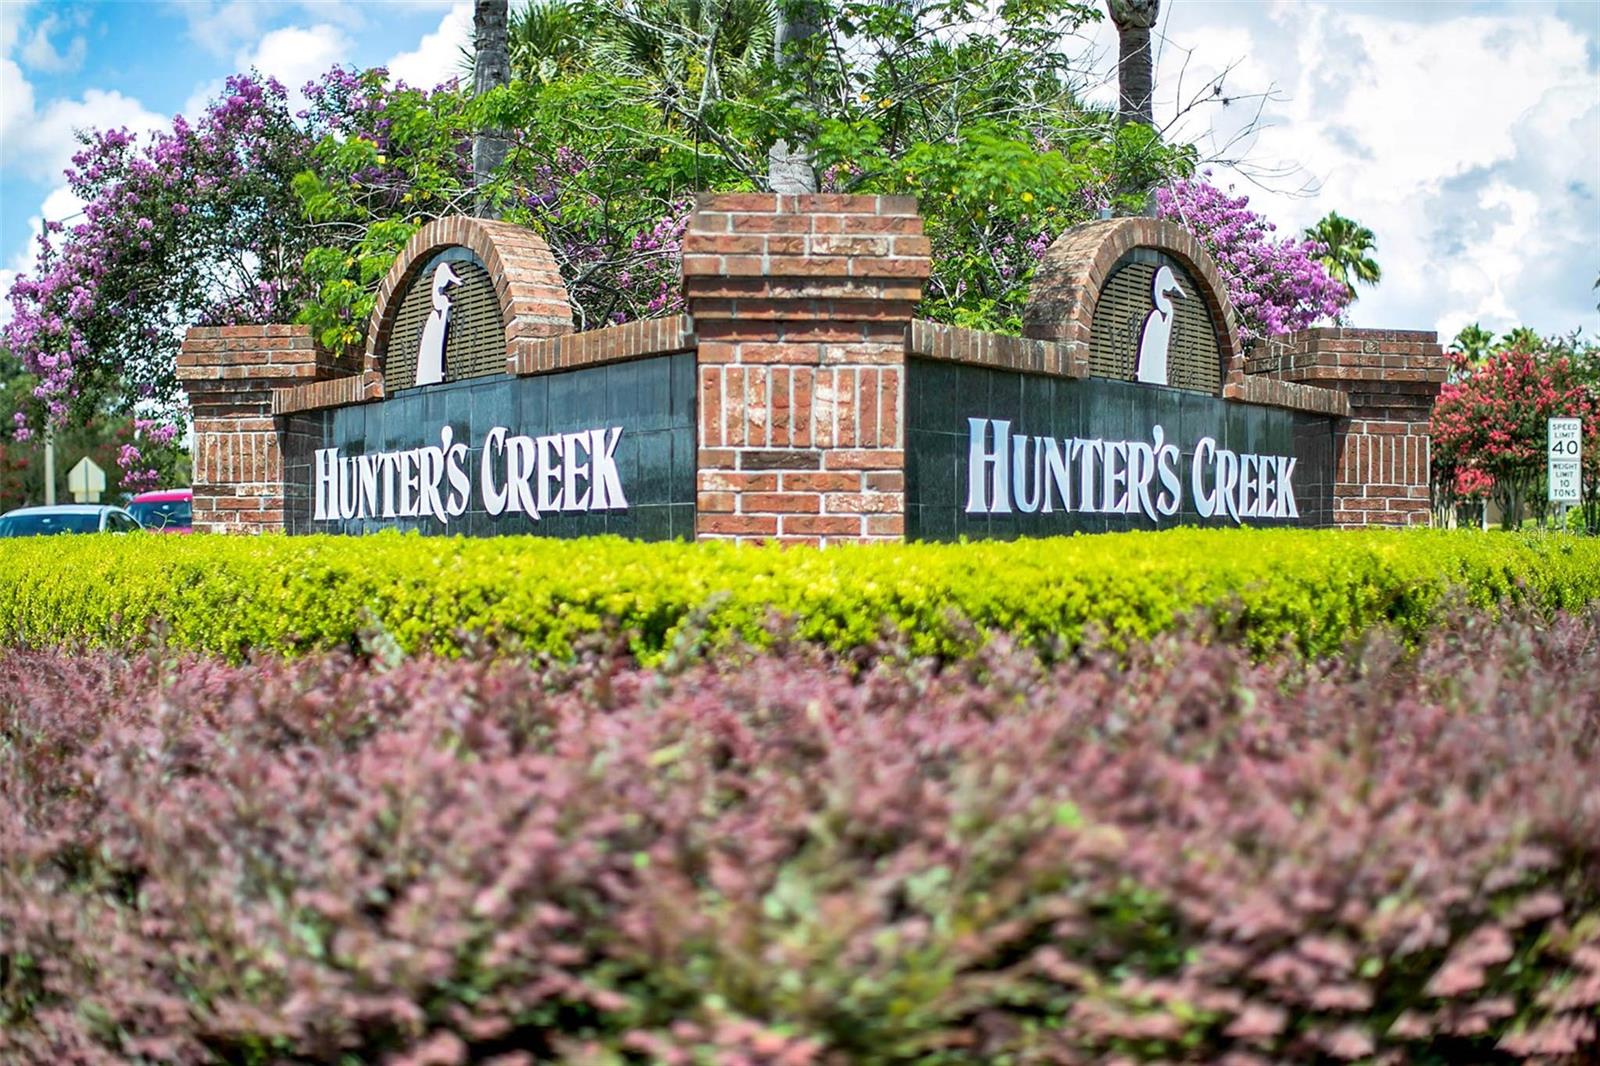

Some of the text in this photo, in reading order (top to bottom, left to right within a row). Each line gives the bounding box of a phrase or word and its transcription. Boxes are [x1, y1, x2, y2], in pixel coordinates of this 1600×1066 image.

[1552, 423, 1578, 431] SPEED
[1552, 440, 1578, 455] 40
[313, 425, 628, 524] HUNTER'S CREEK
[965, 418, 1299, 524] HUNTER'S CREEK
[1560, 479, 1570, 487] 10
[1554, 489, 1577, 497] TONS
